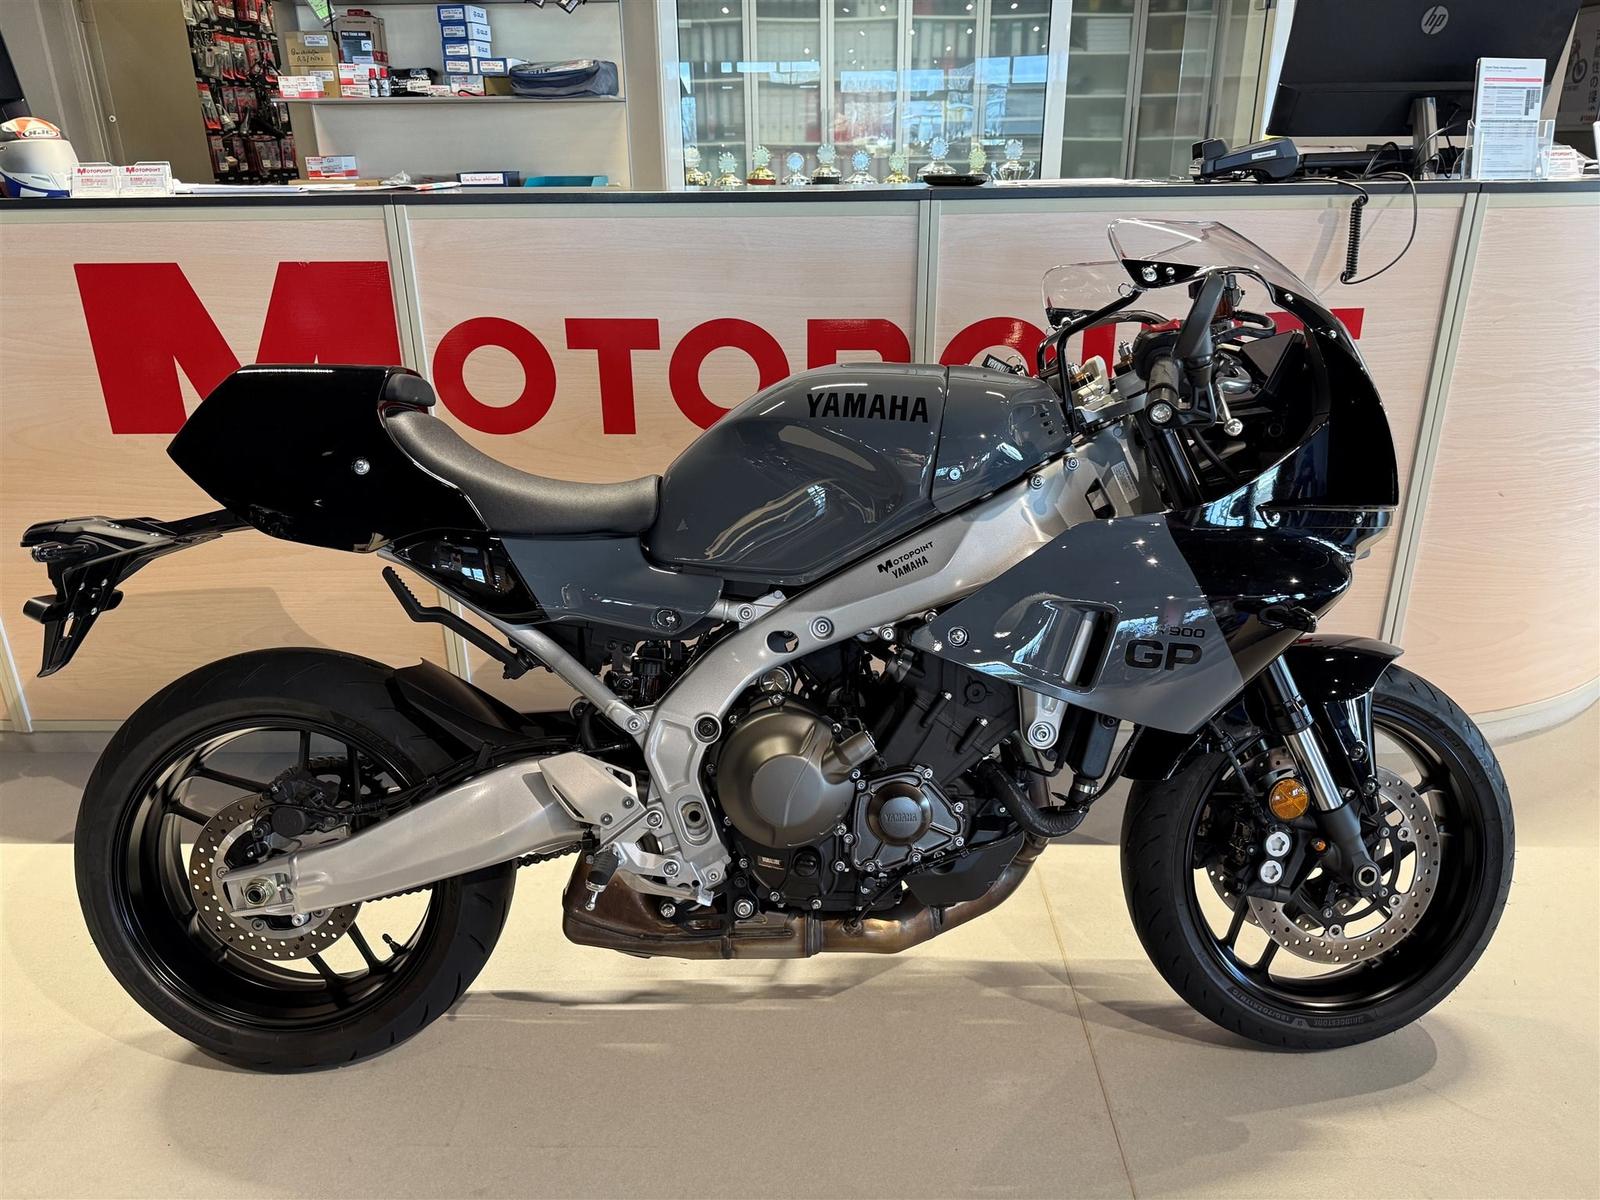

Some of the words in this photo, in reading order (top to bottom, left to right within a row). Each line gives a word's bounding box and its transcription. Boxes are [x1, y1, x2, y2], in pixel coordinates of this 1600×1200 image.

[1422, 5, 1448, 33] hp
[807, 392, 929, 423] YAMAHA
[877, 541, 934, 573] MOTOPOINT
[892, 555, 929, 578] YAMAHA
[1125, 639, 1203, 671] GP
[885, 812, 918, 823] YAMAHA
